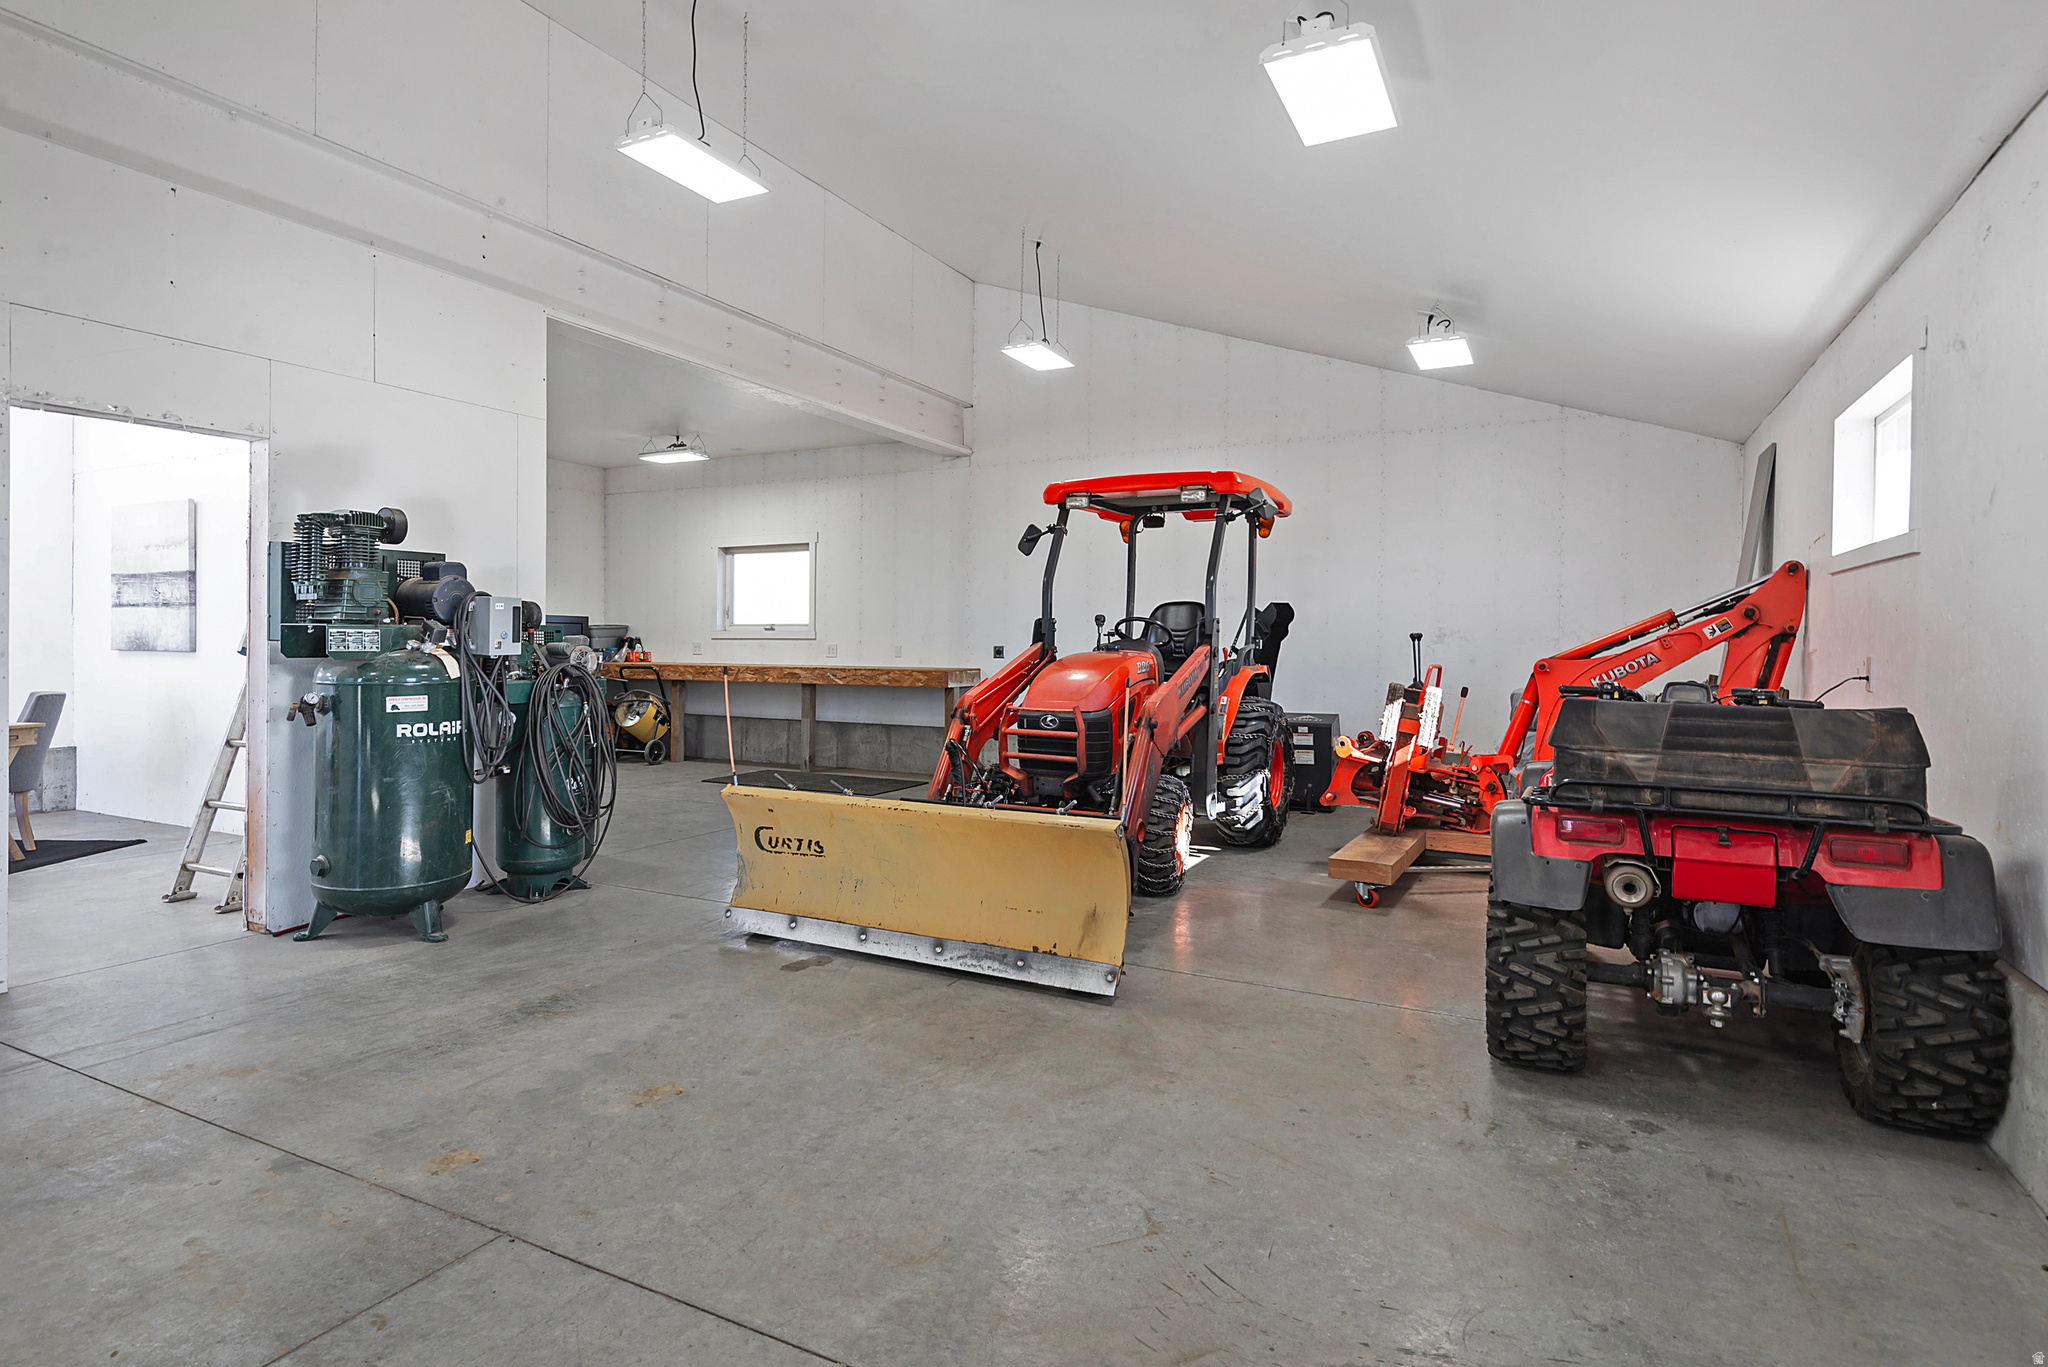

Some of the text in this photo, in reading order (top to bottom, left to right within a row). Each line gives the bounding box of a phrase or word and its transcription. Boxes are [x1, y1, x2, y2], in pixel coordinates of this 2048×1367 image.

[1136, 660, 1150, 674] B26
[1589, 652, 1661, 687] KUBOTA
[1178, 668, 1198, 699] KUBOTA
[754, 826, 824, 856] CURTIS
